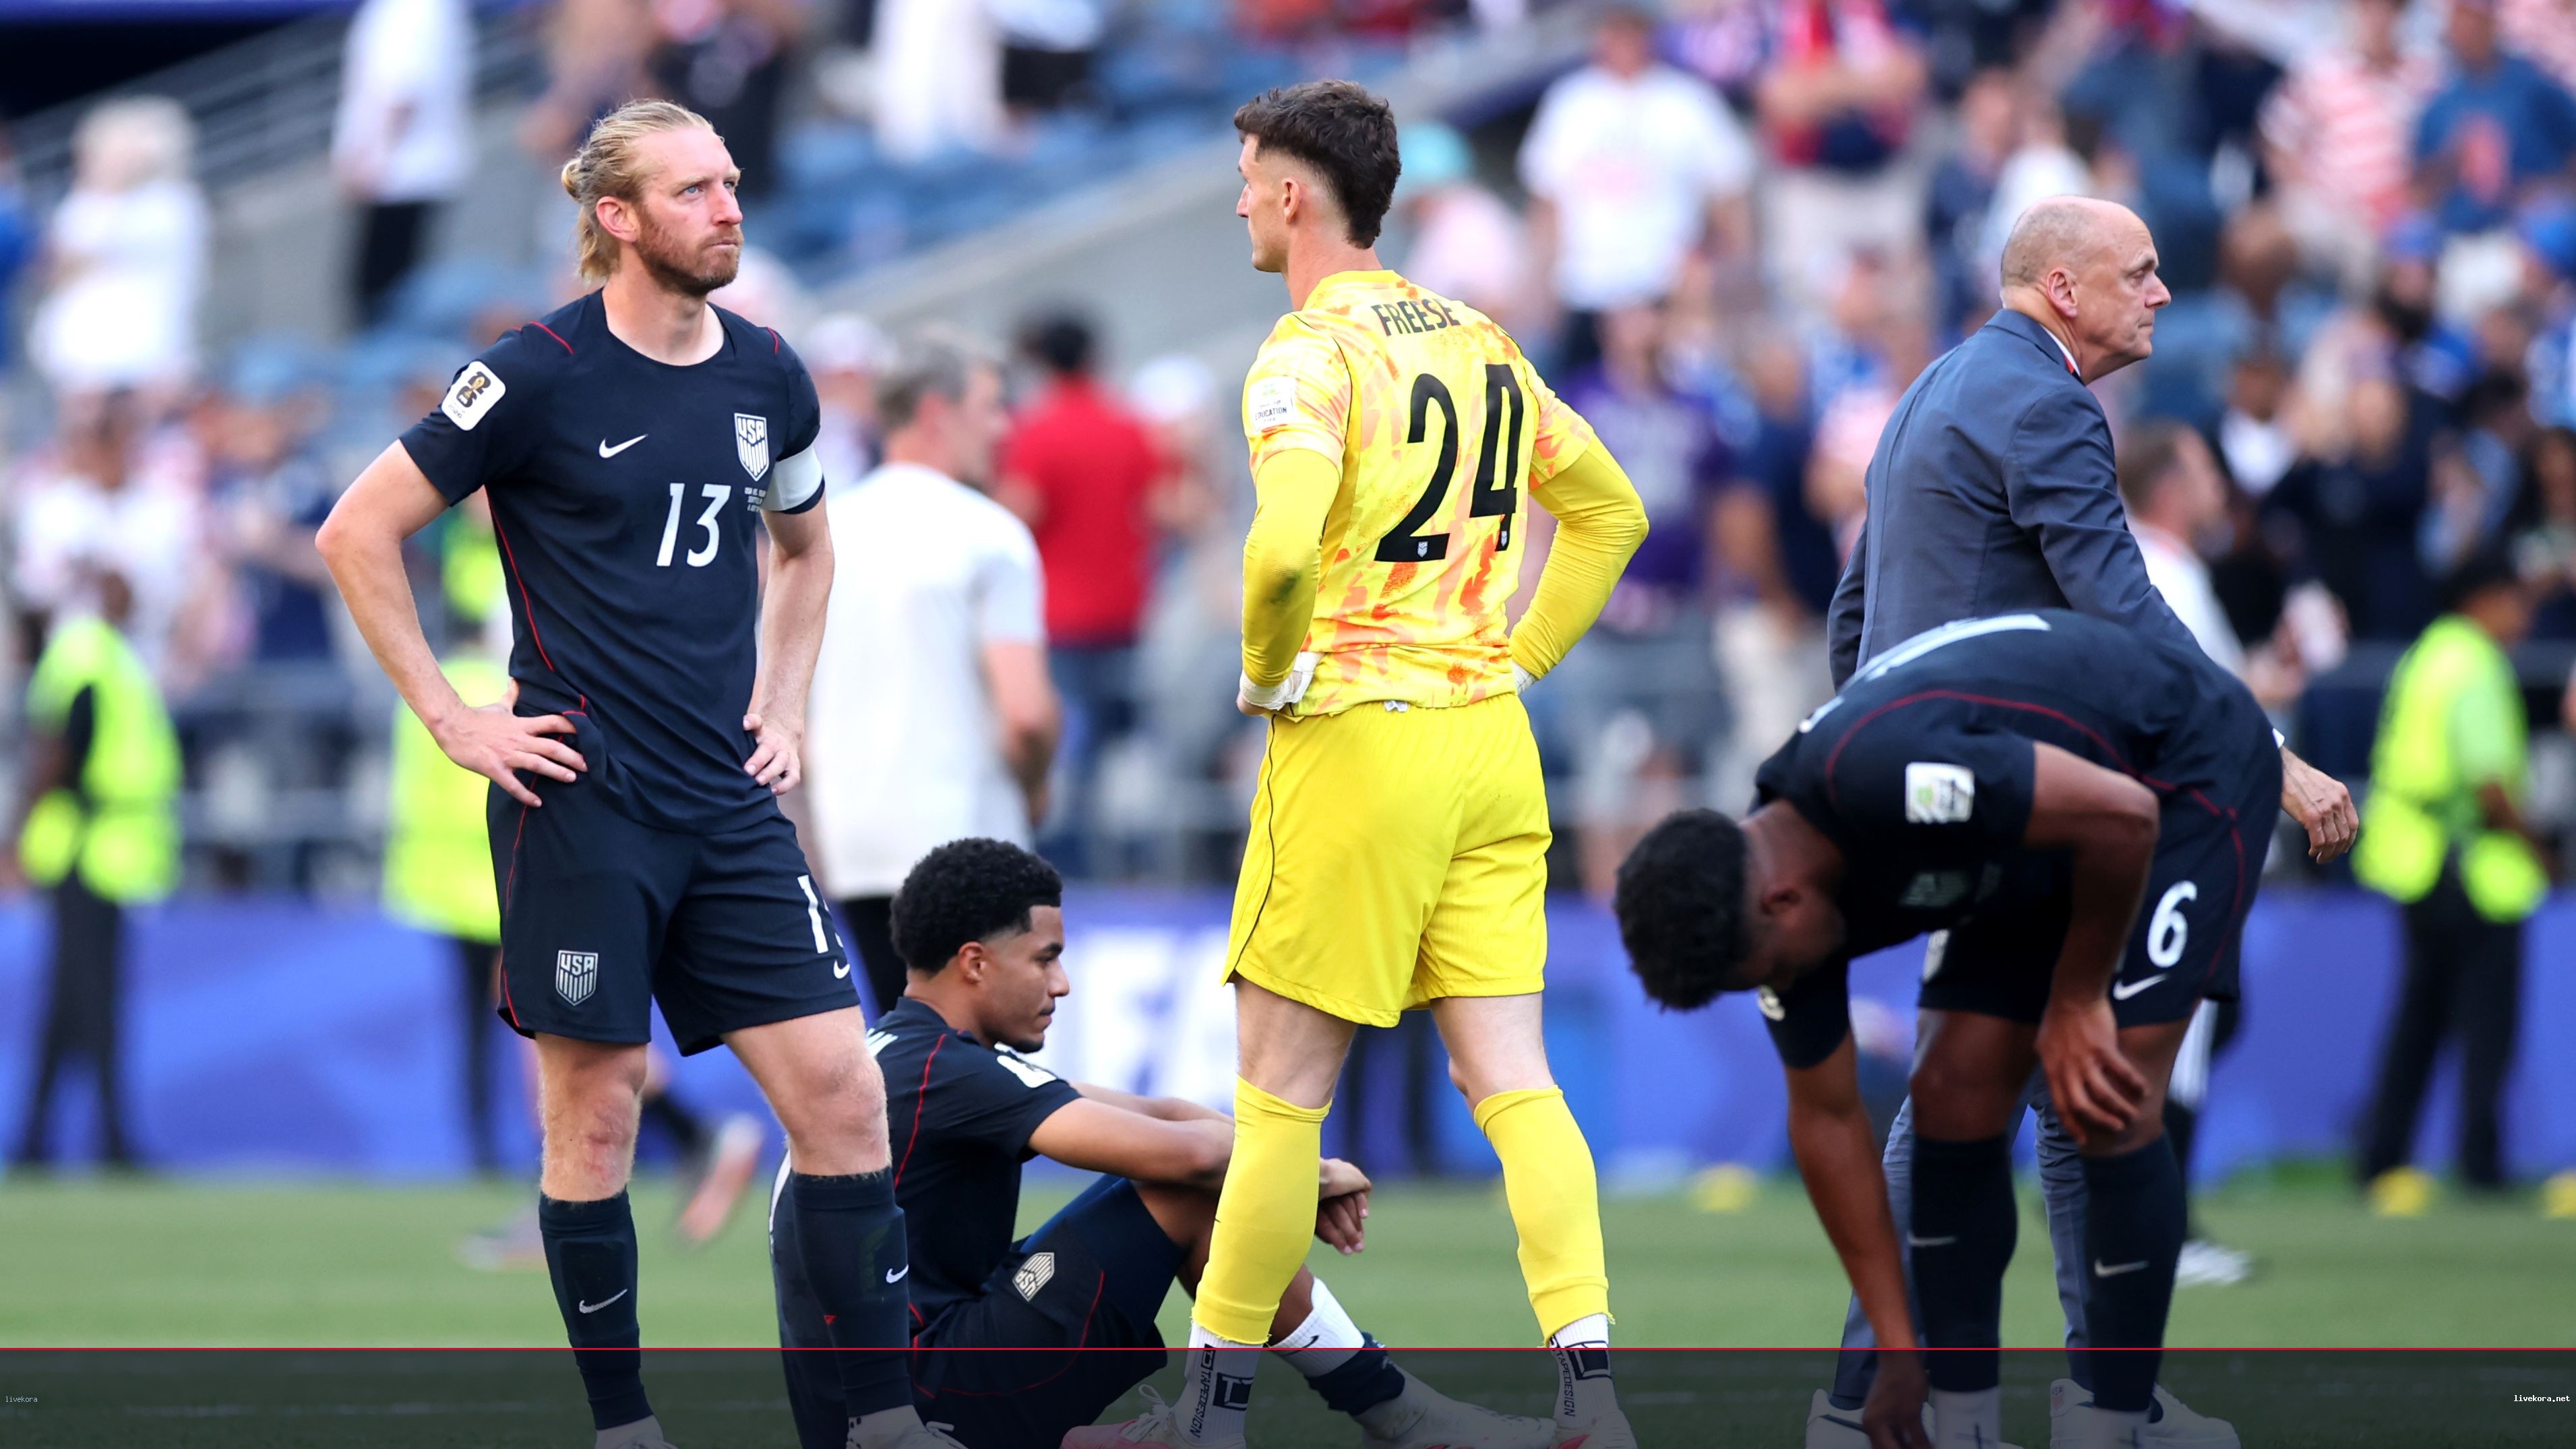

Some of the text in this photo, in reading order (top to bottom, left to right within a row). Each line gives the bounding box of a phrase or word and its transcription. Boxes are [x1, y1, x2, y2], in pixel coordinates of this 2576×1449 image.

[1370, 298, 1461, 337] FREESE
[737, 418, 765, 444] USA
[1374, 364, 1524, 563] 24
[656, 483, 732, 567] 13
[2147, 880, 2198, 968] 6
[560, 954, 594, 976] USA
[1015, 1270, 1037, 1297] USA
[1190, 1371, 1211, 1438] TAPEDESIGN
[1556, 1350, 1576, 1417] TAPEDESIGN
